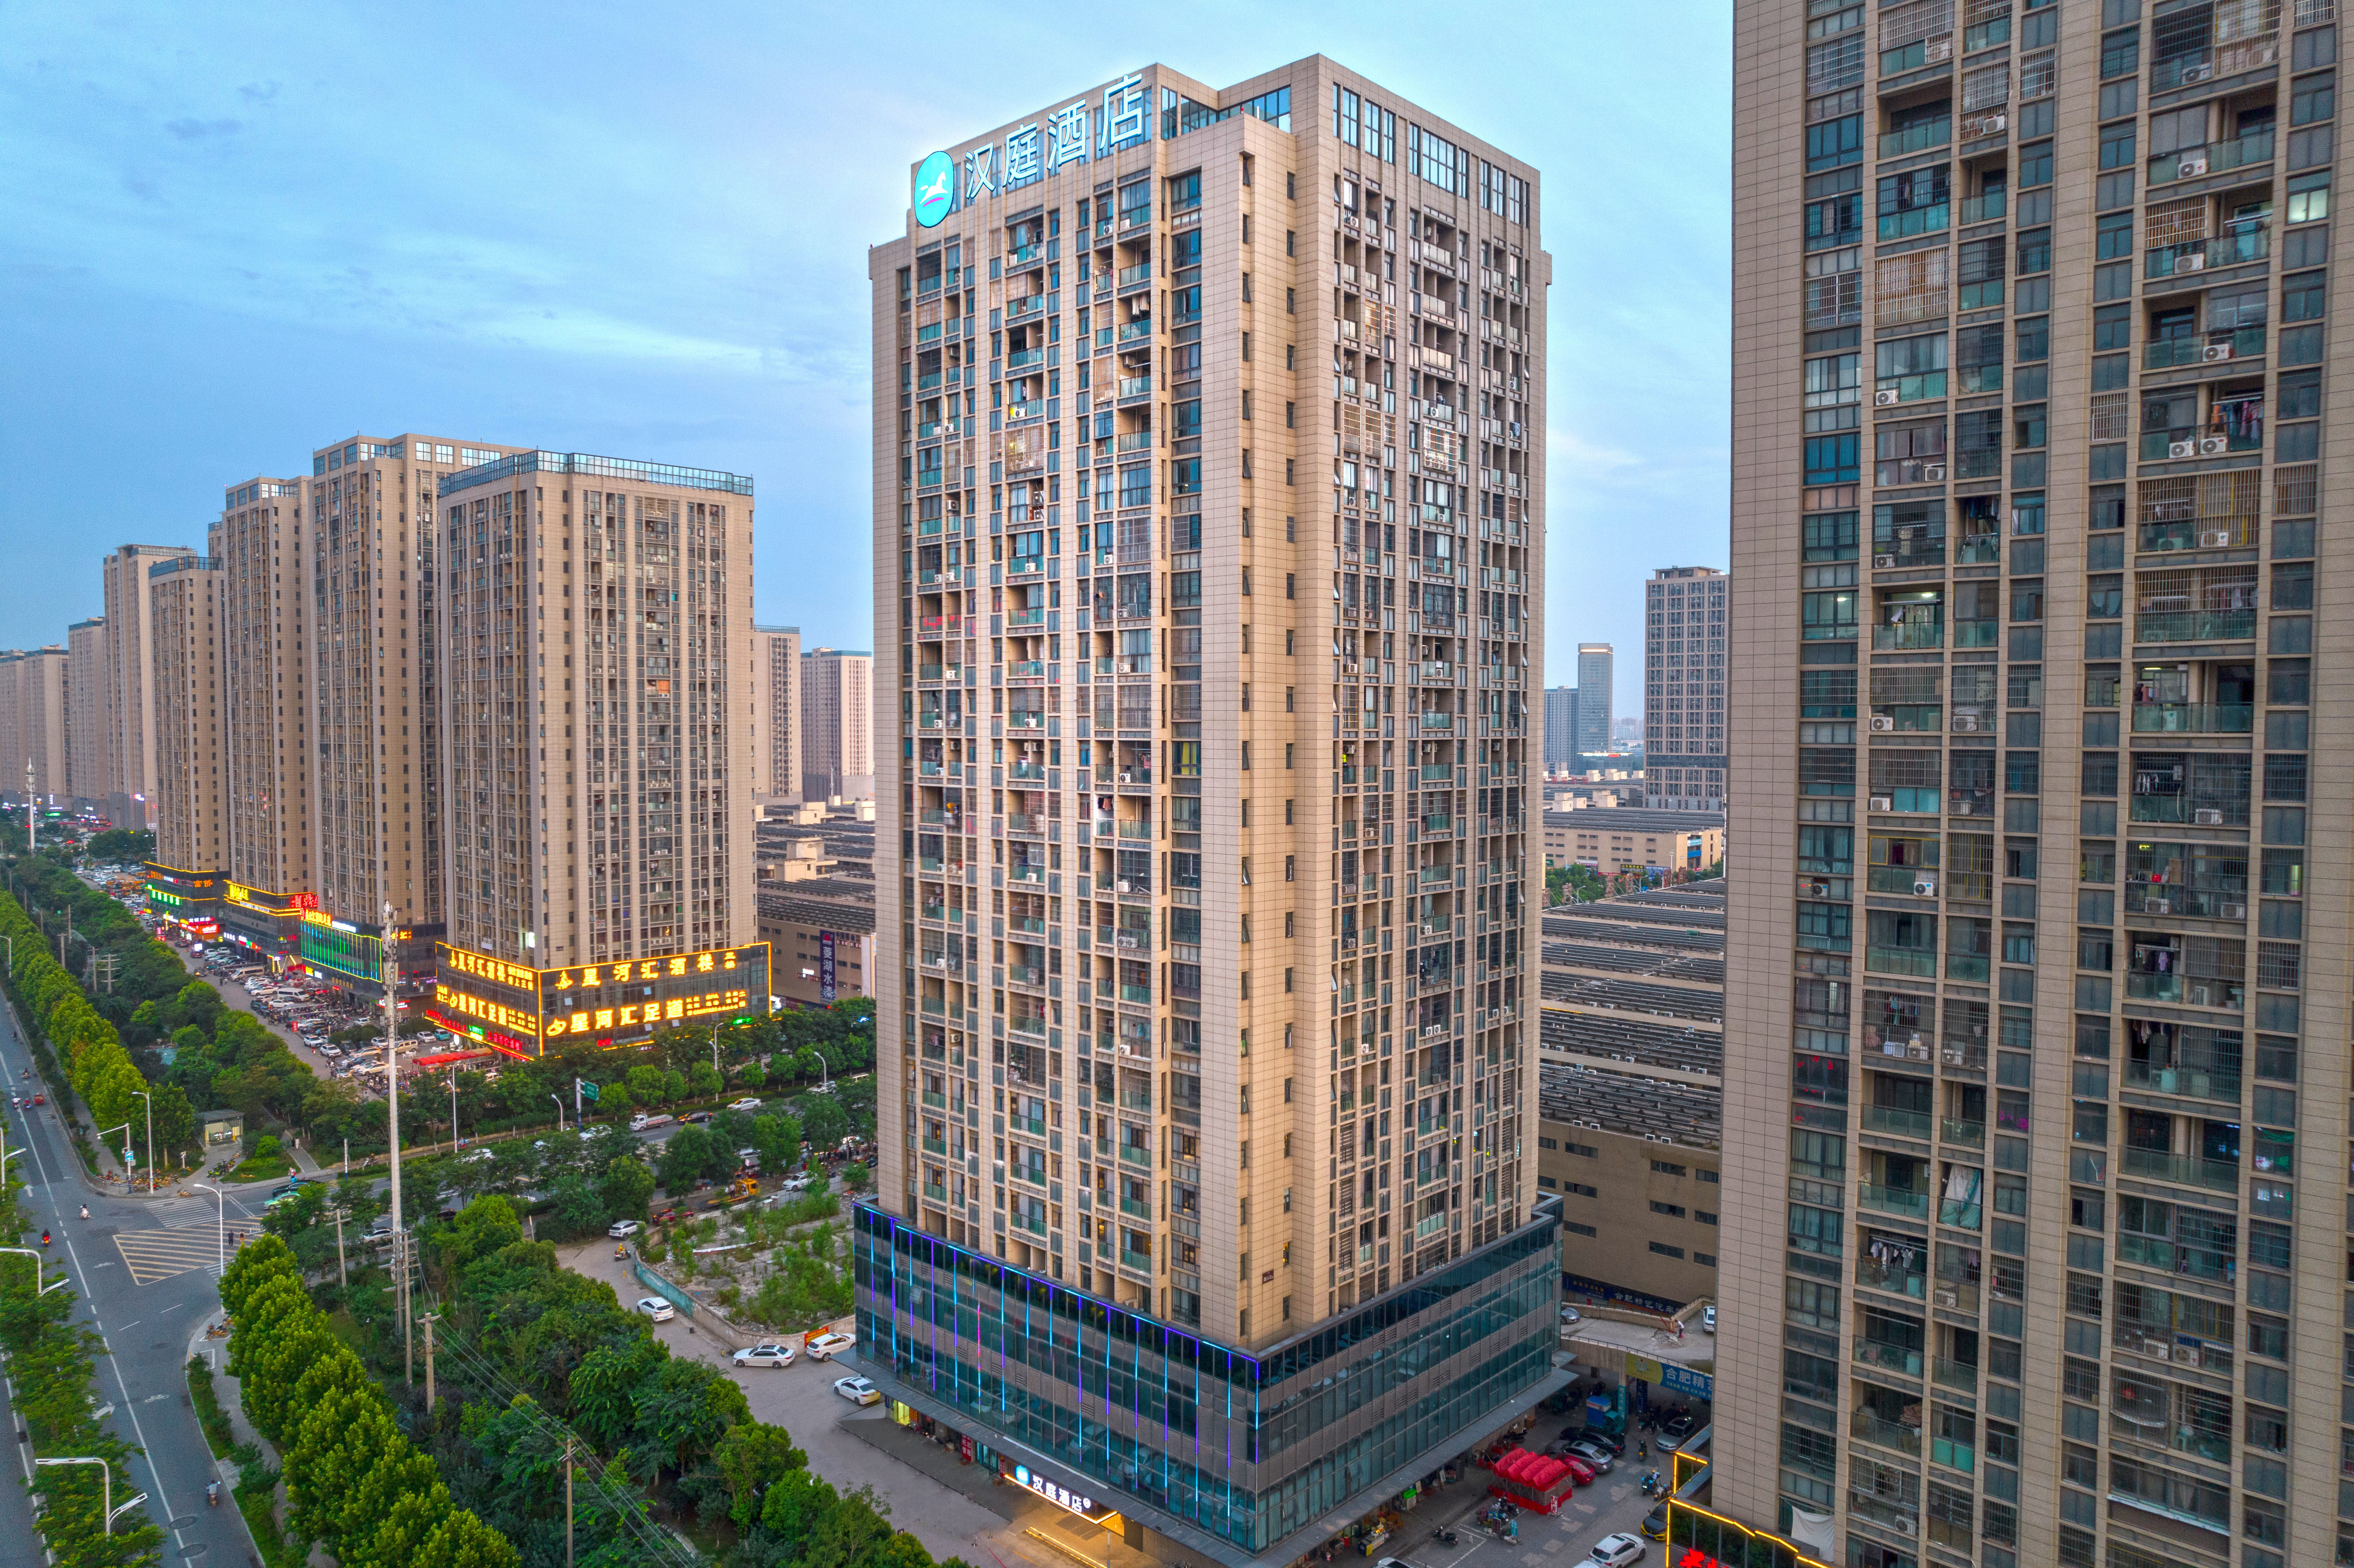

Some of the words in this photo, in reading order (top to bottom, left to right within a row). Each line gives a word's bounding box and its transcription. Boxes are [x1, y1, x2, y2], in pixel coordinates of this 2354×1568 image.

[965, 72, 1143, 199] 汉庭酒店
[458, 952, 506, 982] 星河汇酒楼
[582, 952, 714, 986] 星河汇酒楼
[823, 947, 833, 999] 菱湖水漆
[458, 992, 507, 1026] 星河汇足道
[570, 999, 685, 1033] 星河汇足道
[1033, 1475, 1082, 1513] 汉庭酒店
